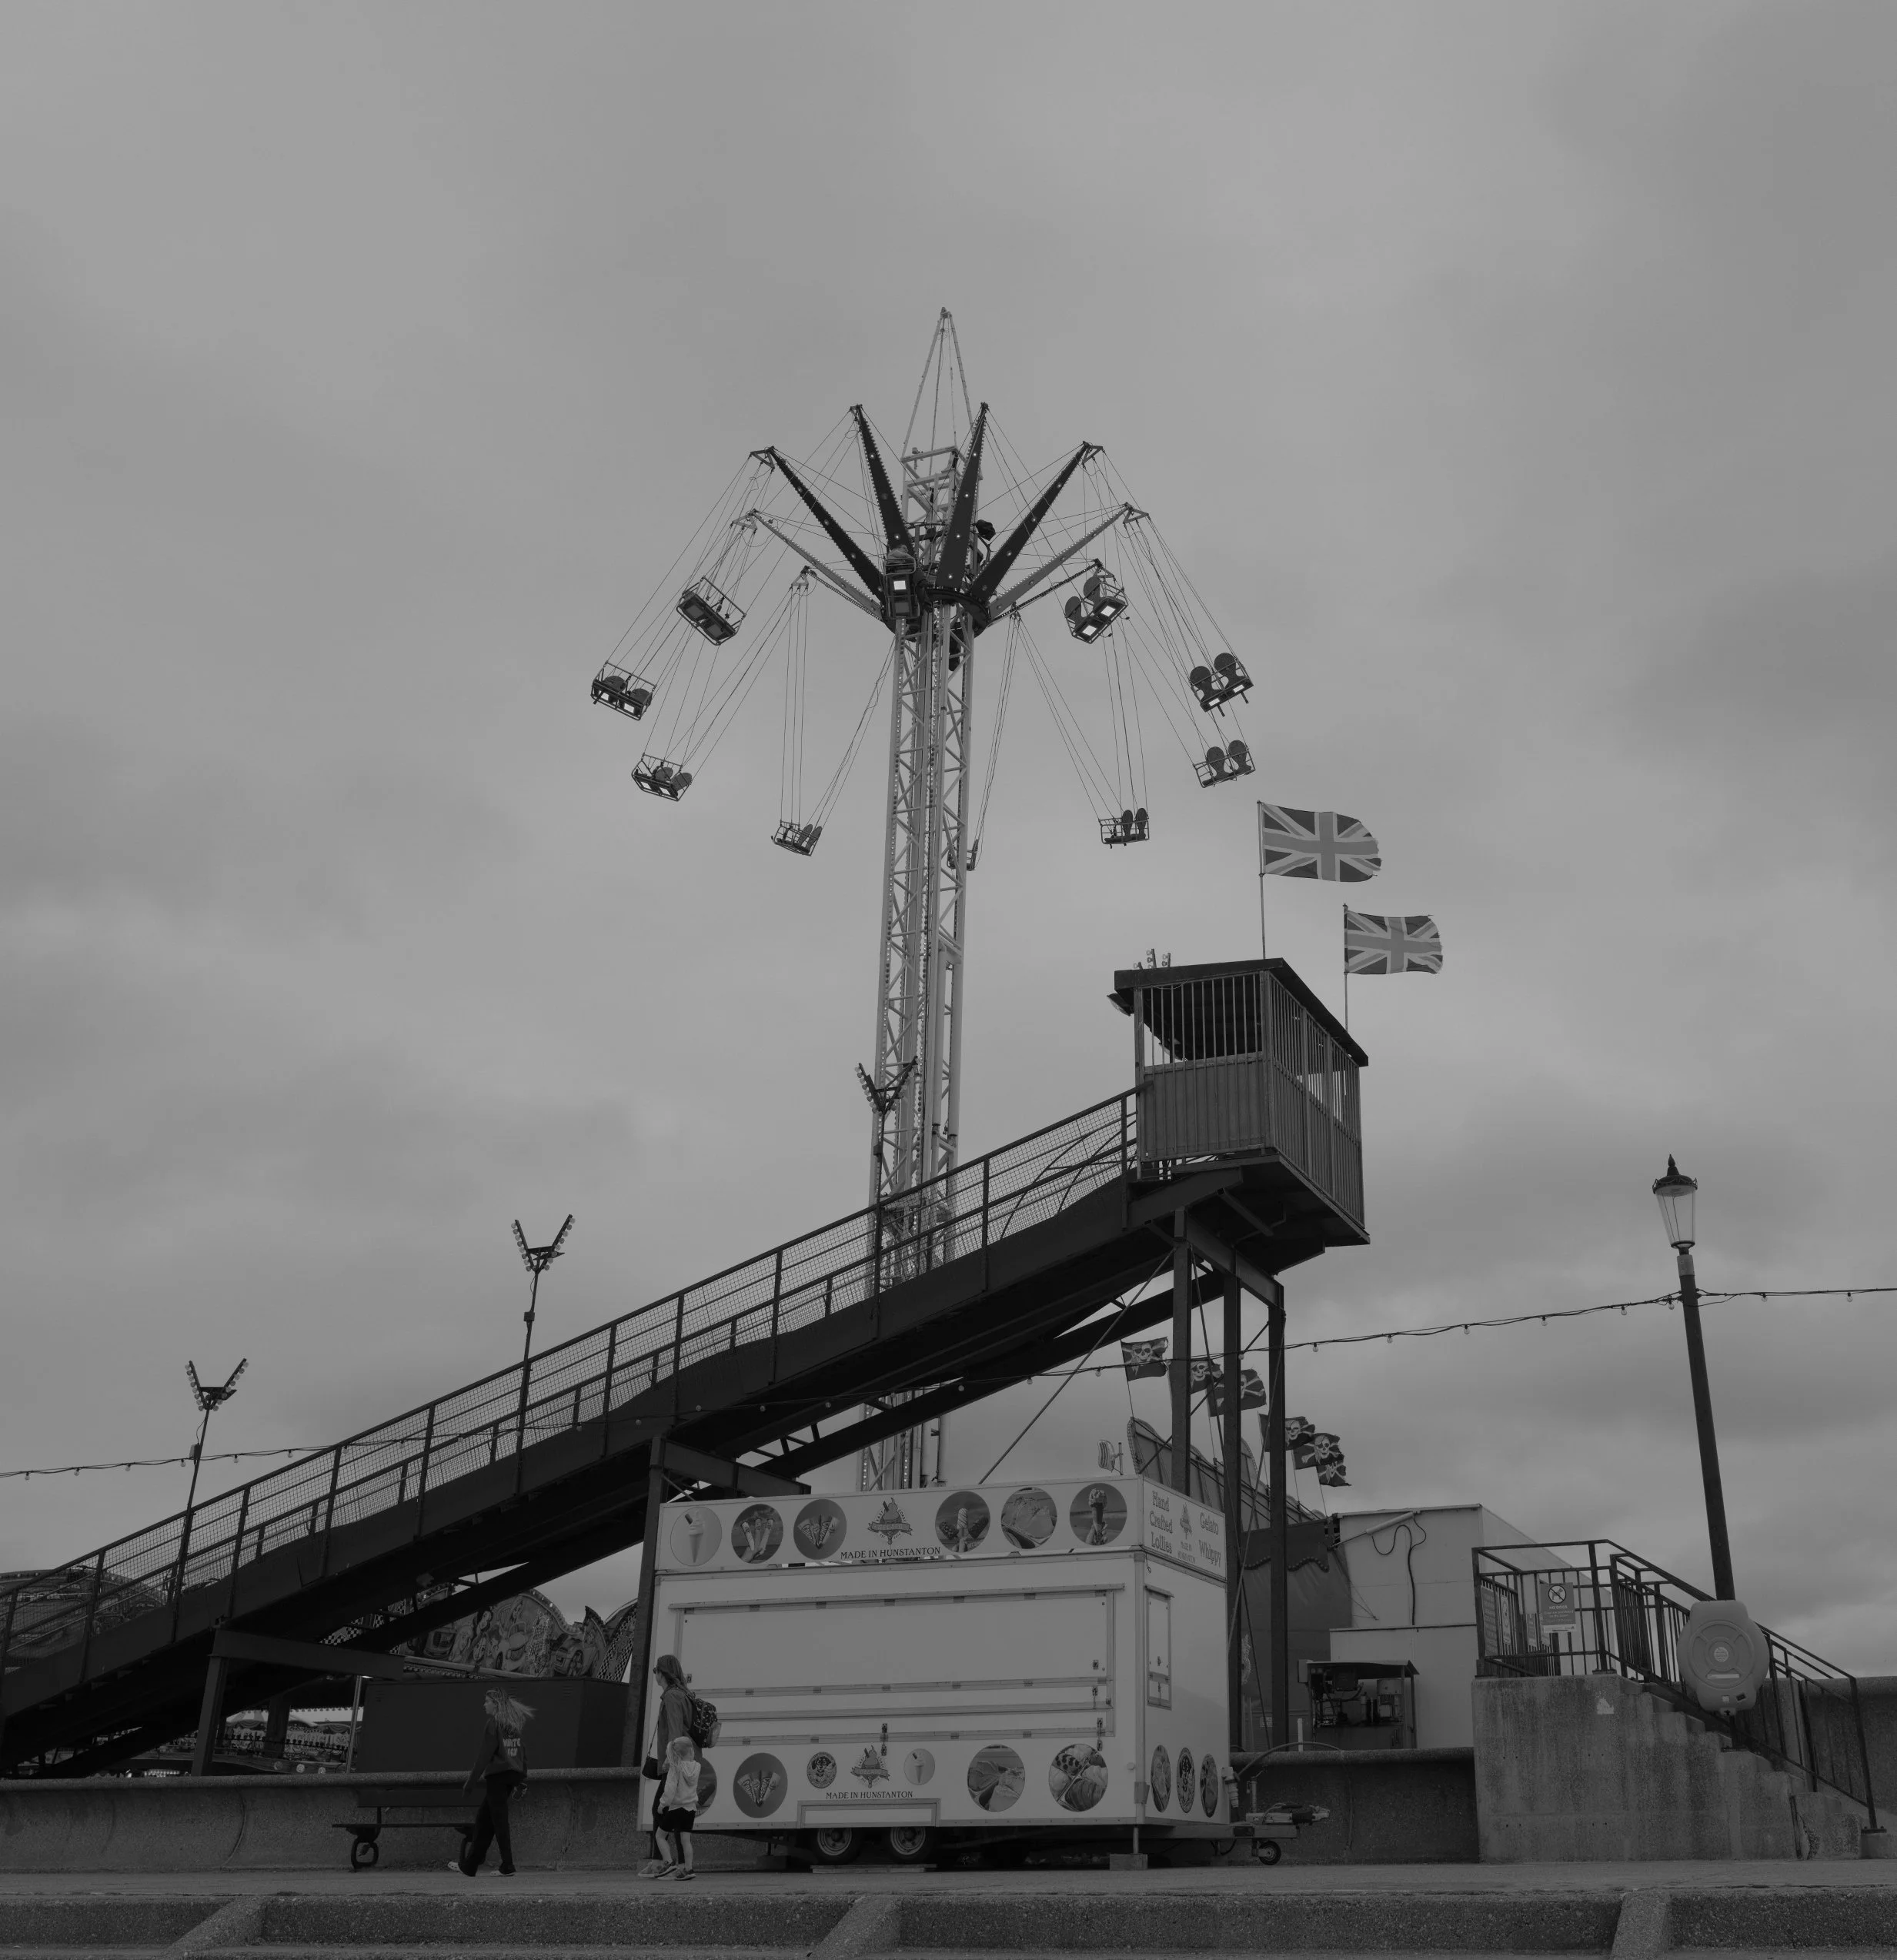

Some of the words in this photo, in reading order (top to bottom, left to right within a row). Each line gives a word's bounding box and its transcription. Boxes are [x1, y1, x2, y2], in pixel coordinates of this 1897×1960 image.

[1152, 1491, 1169, 1511] Hand
[1149, 1510, 1173, 1534] Crafted
[1200, 1512, 1219, 1535] Gelato
[1151, 1531, 1172, 1554] Lollies
[840, 1551, 866, 1560] MADE
[868, 1550, 877, 1558] IN
[880, 1547, 940, 1558] HUNSTANTON
[1198, 1539, 1221, 1568] Whippy
[503, 1738, 521, 1747] WHITE
[507, 1748, 518, 1757] FOX
